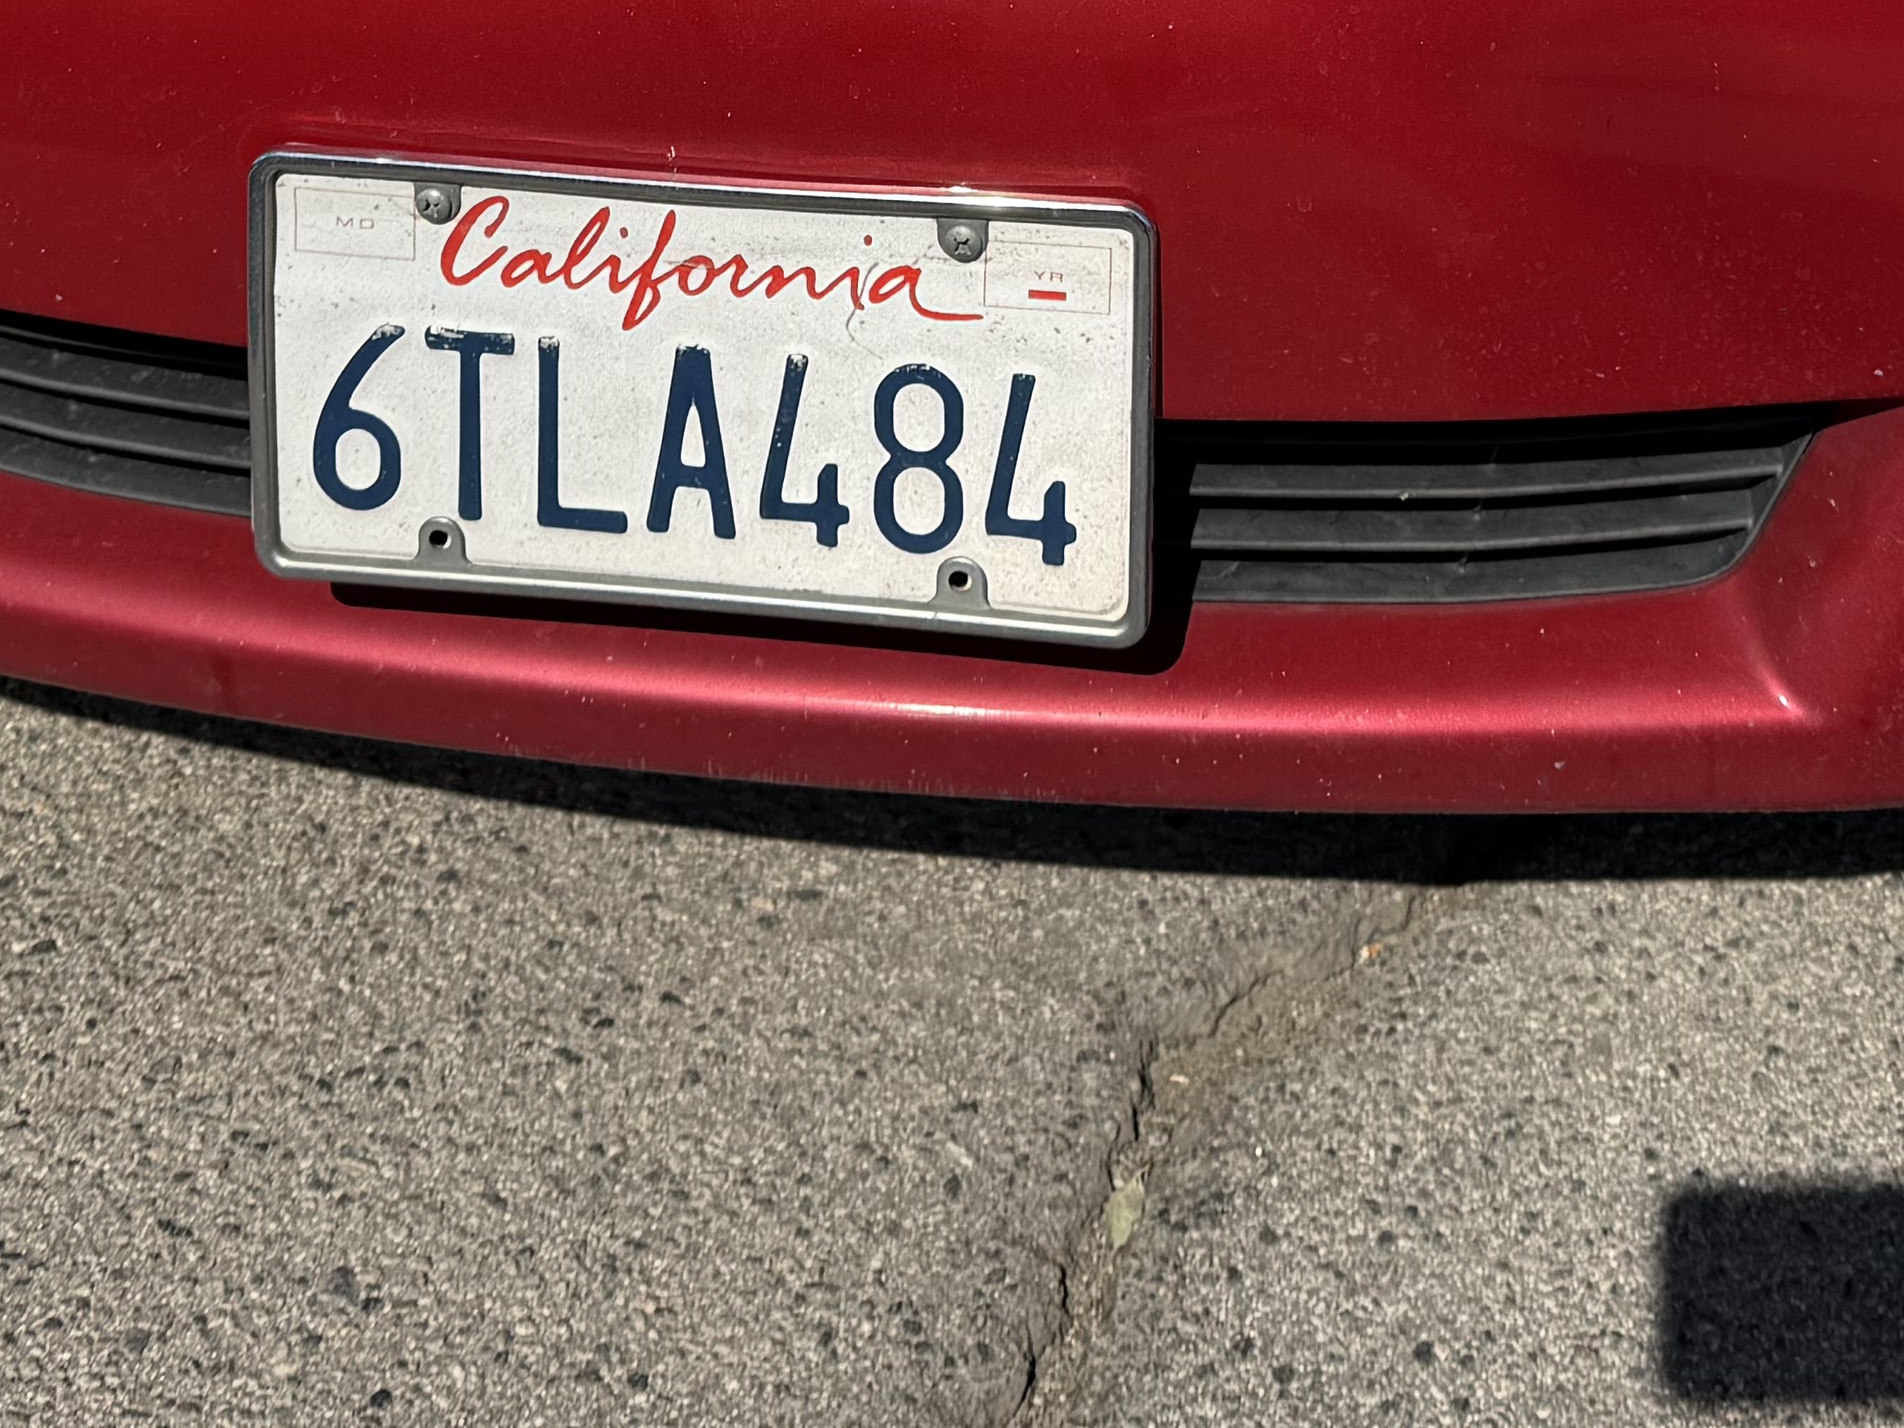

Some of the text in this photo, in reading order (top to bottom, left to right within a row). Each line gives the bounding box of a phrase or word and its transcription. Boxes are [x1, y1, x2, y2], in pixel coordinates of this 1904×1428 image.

[440, 195, 984, 332] California
[1032, 269, 1066, 285] YR
[311, 322, 1079, 568] 6TLA484
